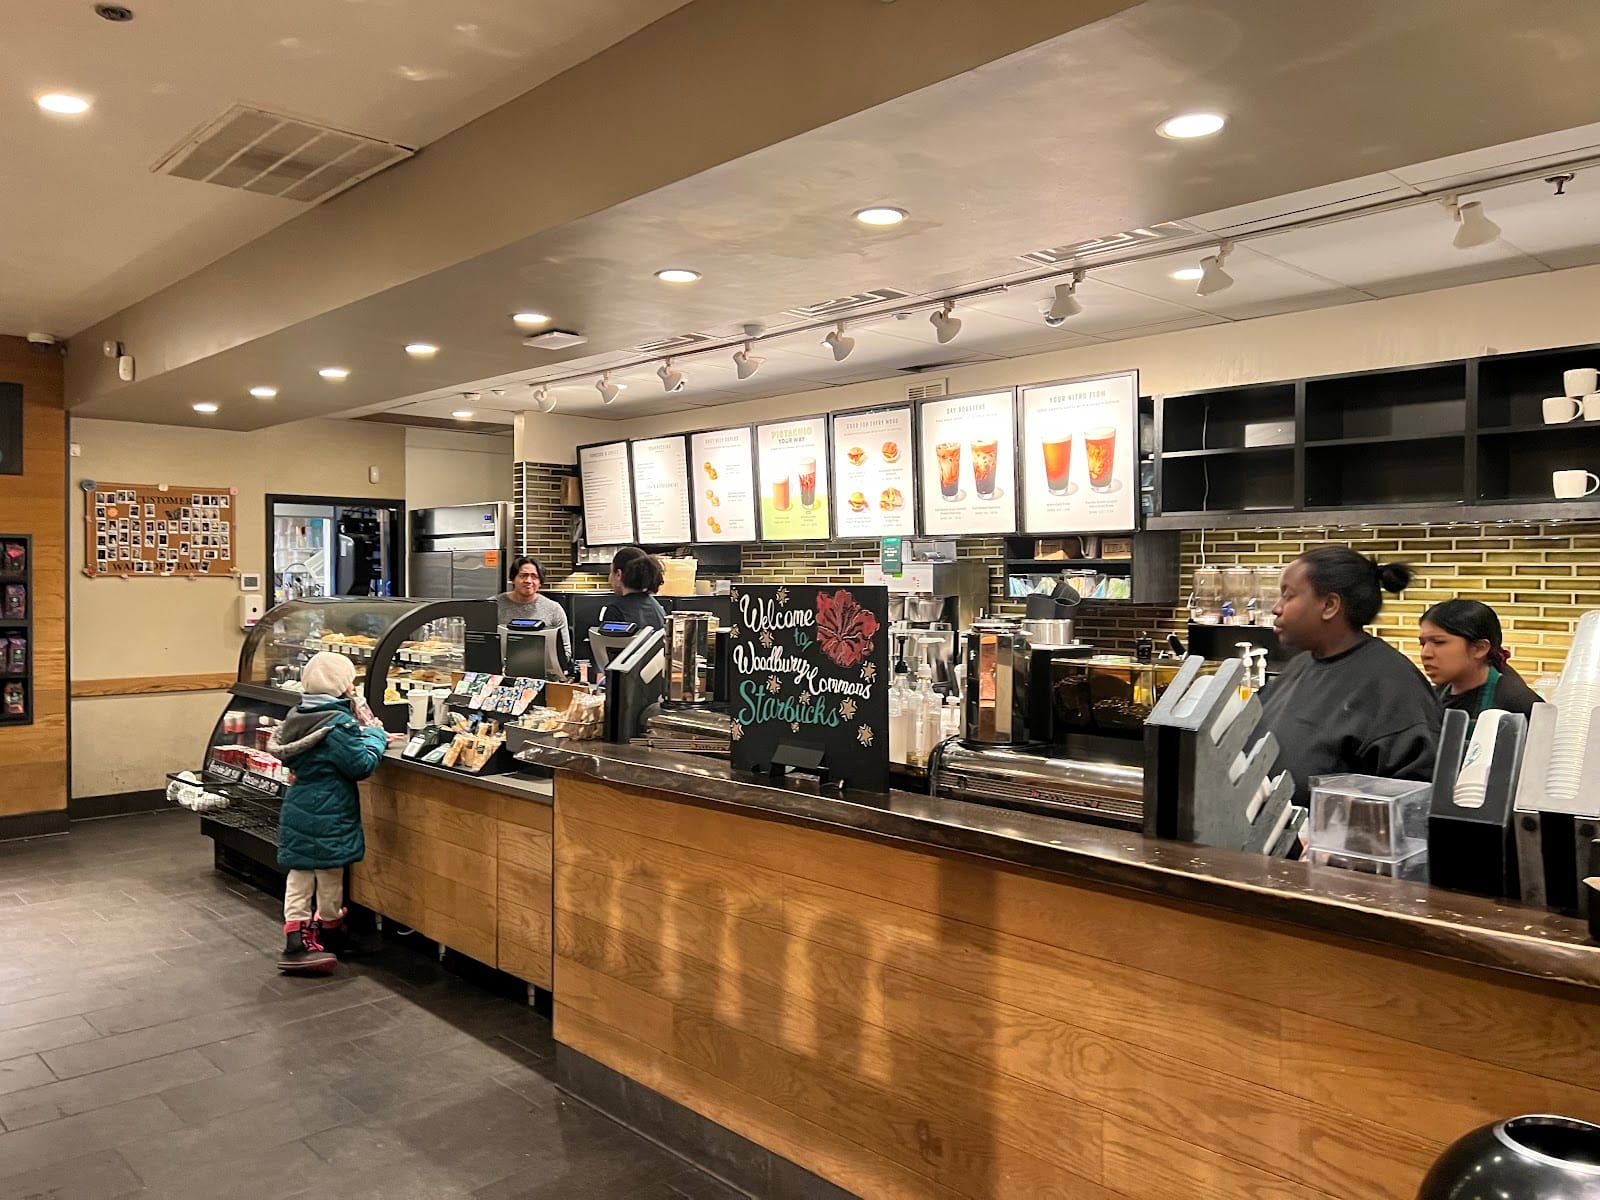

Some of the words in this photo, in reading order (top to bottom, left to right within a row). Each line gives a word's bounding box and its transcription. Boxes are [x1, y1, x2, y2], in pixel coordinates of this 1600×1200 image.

[1049, 395, 1066, 404] YOUR
[771, 426, 813, 439] PISTACHIO
[176, 562, 200, 572] FAM
[739, 593, 815, 632] Welcome
[794, 627, 813, 651] to
[733, 641, 810, 685] Woodbury
[807, 666, 872, 700] Commons
[738, 680, 840, 728] Starbucks
